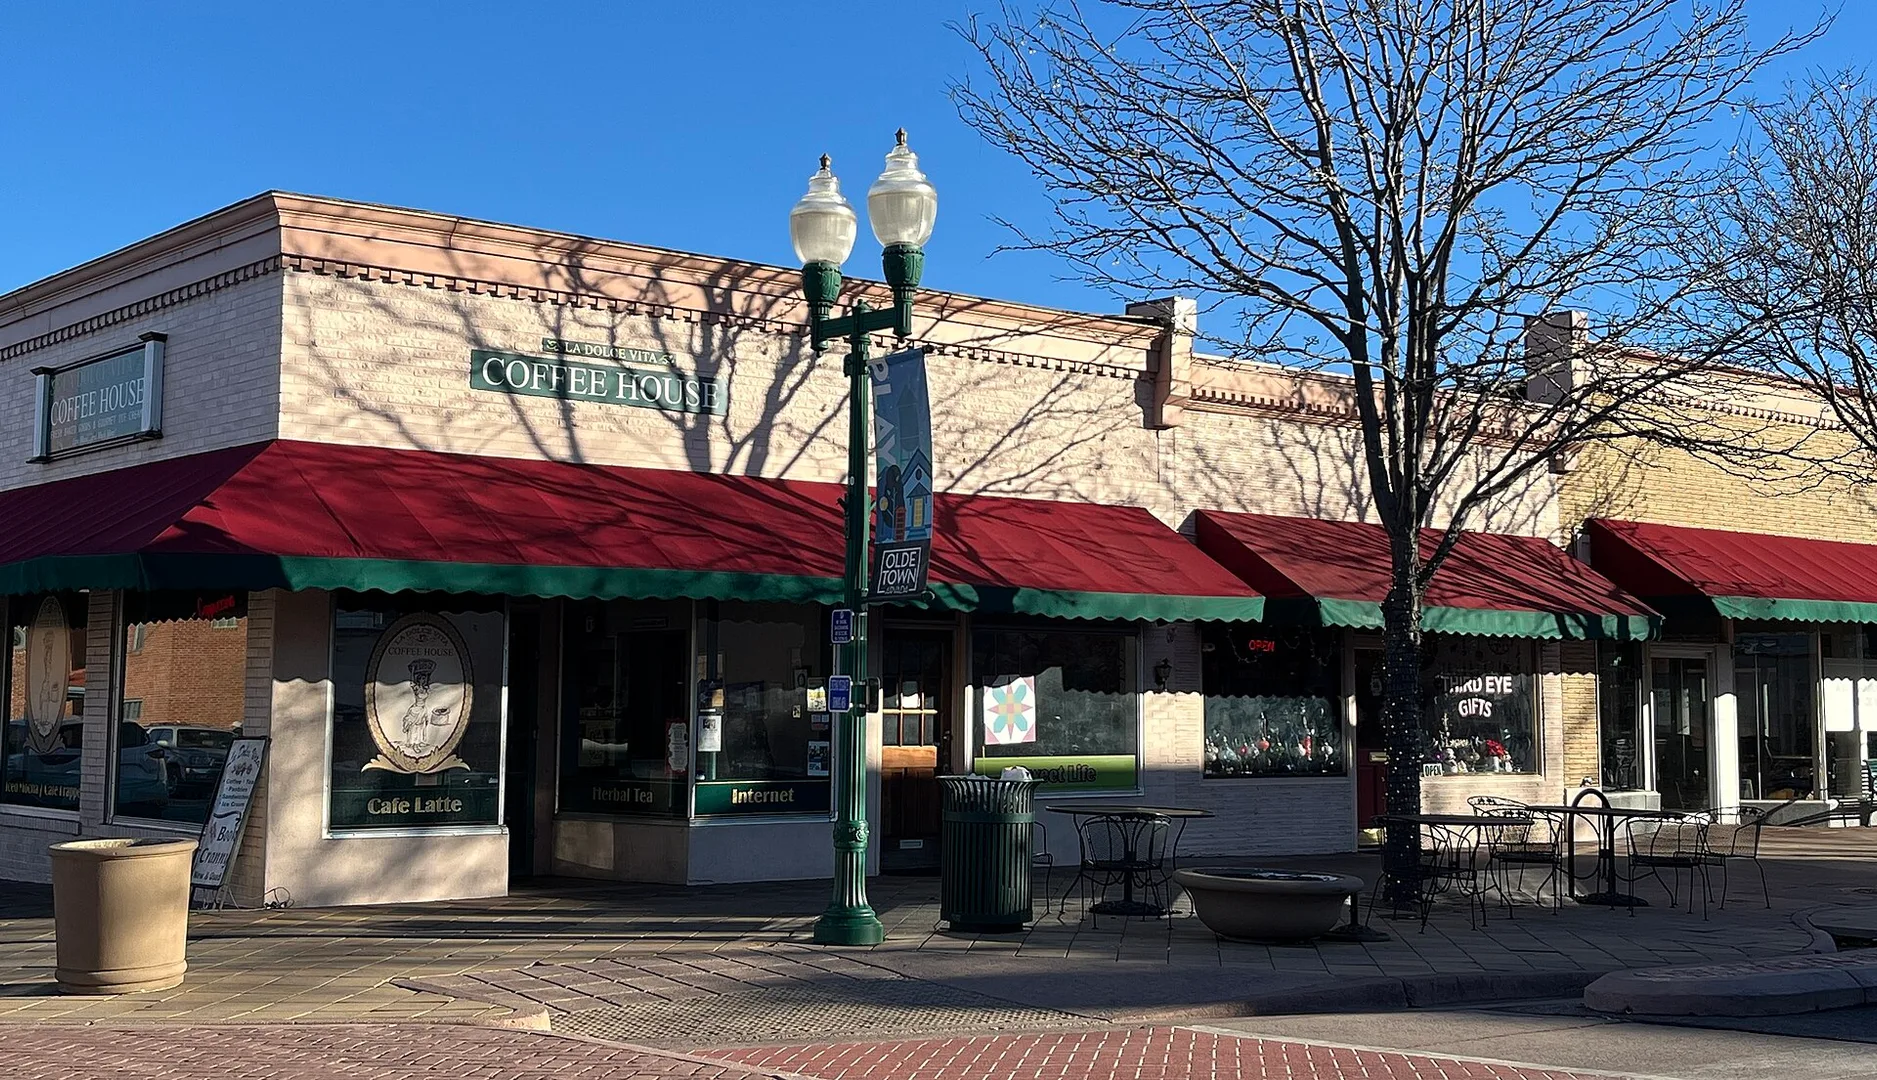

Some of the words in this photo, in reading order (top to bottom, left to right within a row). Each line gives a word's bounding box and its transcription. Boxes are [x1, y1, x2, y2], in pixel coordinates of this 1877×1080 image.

[565, 343, 580, 355] LA
[585, 344, 626, 359] DOLCE
[630, 350, 658, 364] VITA
[482, 357, 607, 397] COFFEE
[616, 372, 720, 409] HOUSE
[51, 390, 96, 426] COFFEE
[99, 377, 144, 414] HOUSE
[866, 357, 897, 466] PLAY
[885, 551, 917, 569] OLDE
[882, 568, 917, 585] TOWN
[388, 646, 422, 656] COFFEE
[424, 647, 454, 657] HOUSE
[1248, 639, 1275, 652] OPEN
[1441, 676, 1483, 694] THIRD
[1485, 675, 1513, 695] EYE
[1458, 697, 1493, 718] GIFTS
[1029, 764, 1065, 783] weet
[1067, 764, 1097, 782] Life
[592, 786, 630, 802] Herbal
[633, 787, 653, 803] Tea
[732, 788, 795, 803] Internet
[414, 796, 462, 813] Latte
